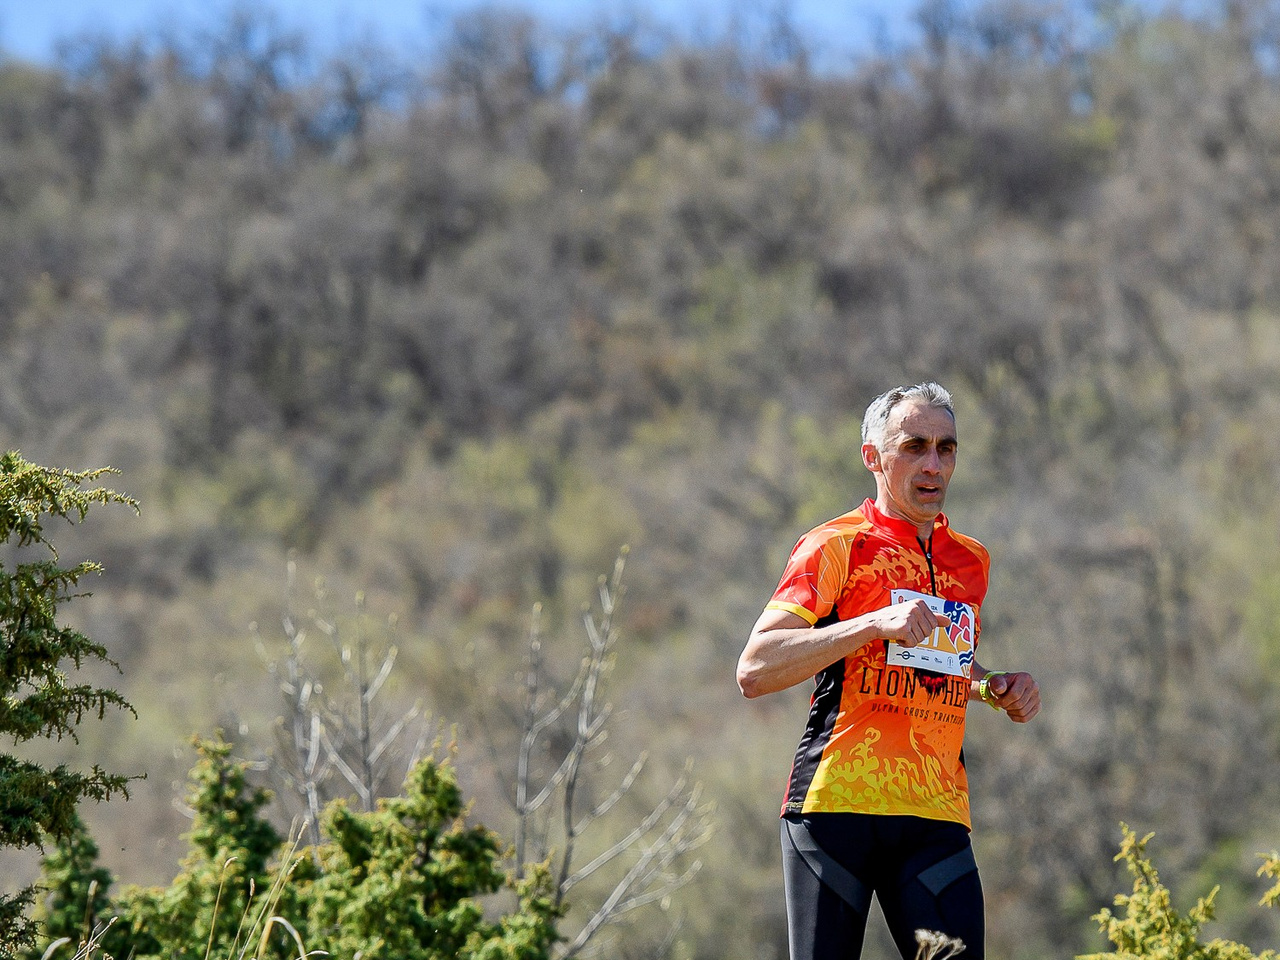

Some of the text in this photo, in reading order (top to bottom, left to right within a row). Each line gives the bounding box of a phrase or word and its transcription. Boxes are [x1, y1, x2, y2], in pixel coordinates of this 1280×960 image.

[859, 666, 971, 709] LION HEA
[871, 703, 899, 714] ULTRA
[903, 706, 930, 719] CROSS
